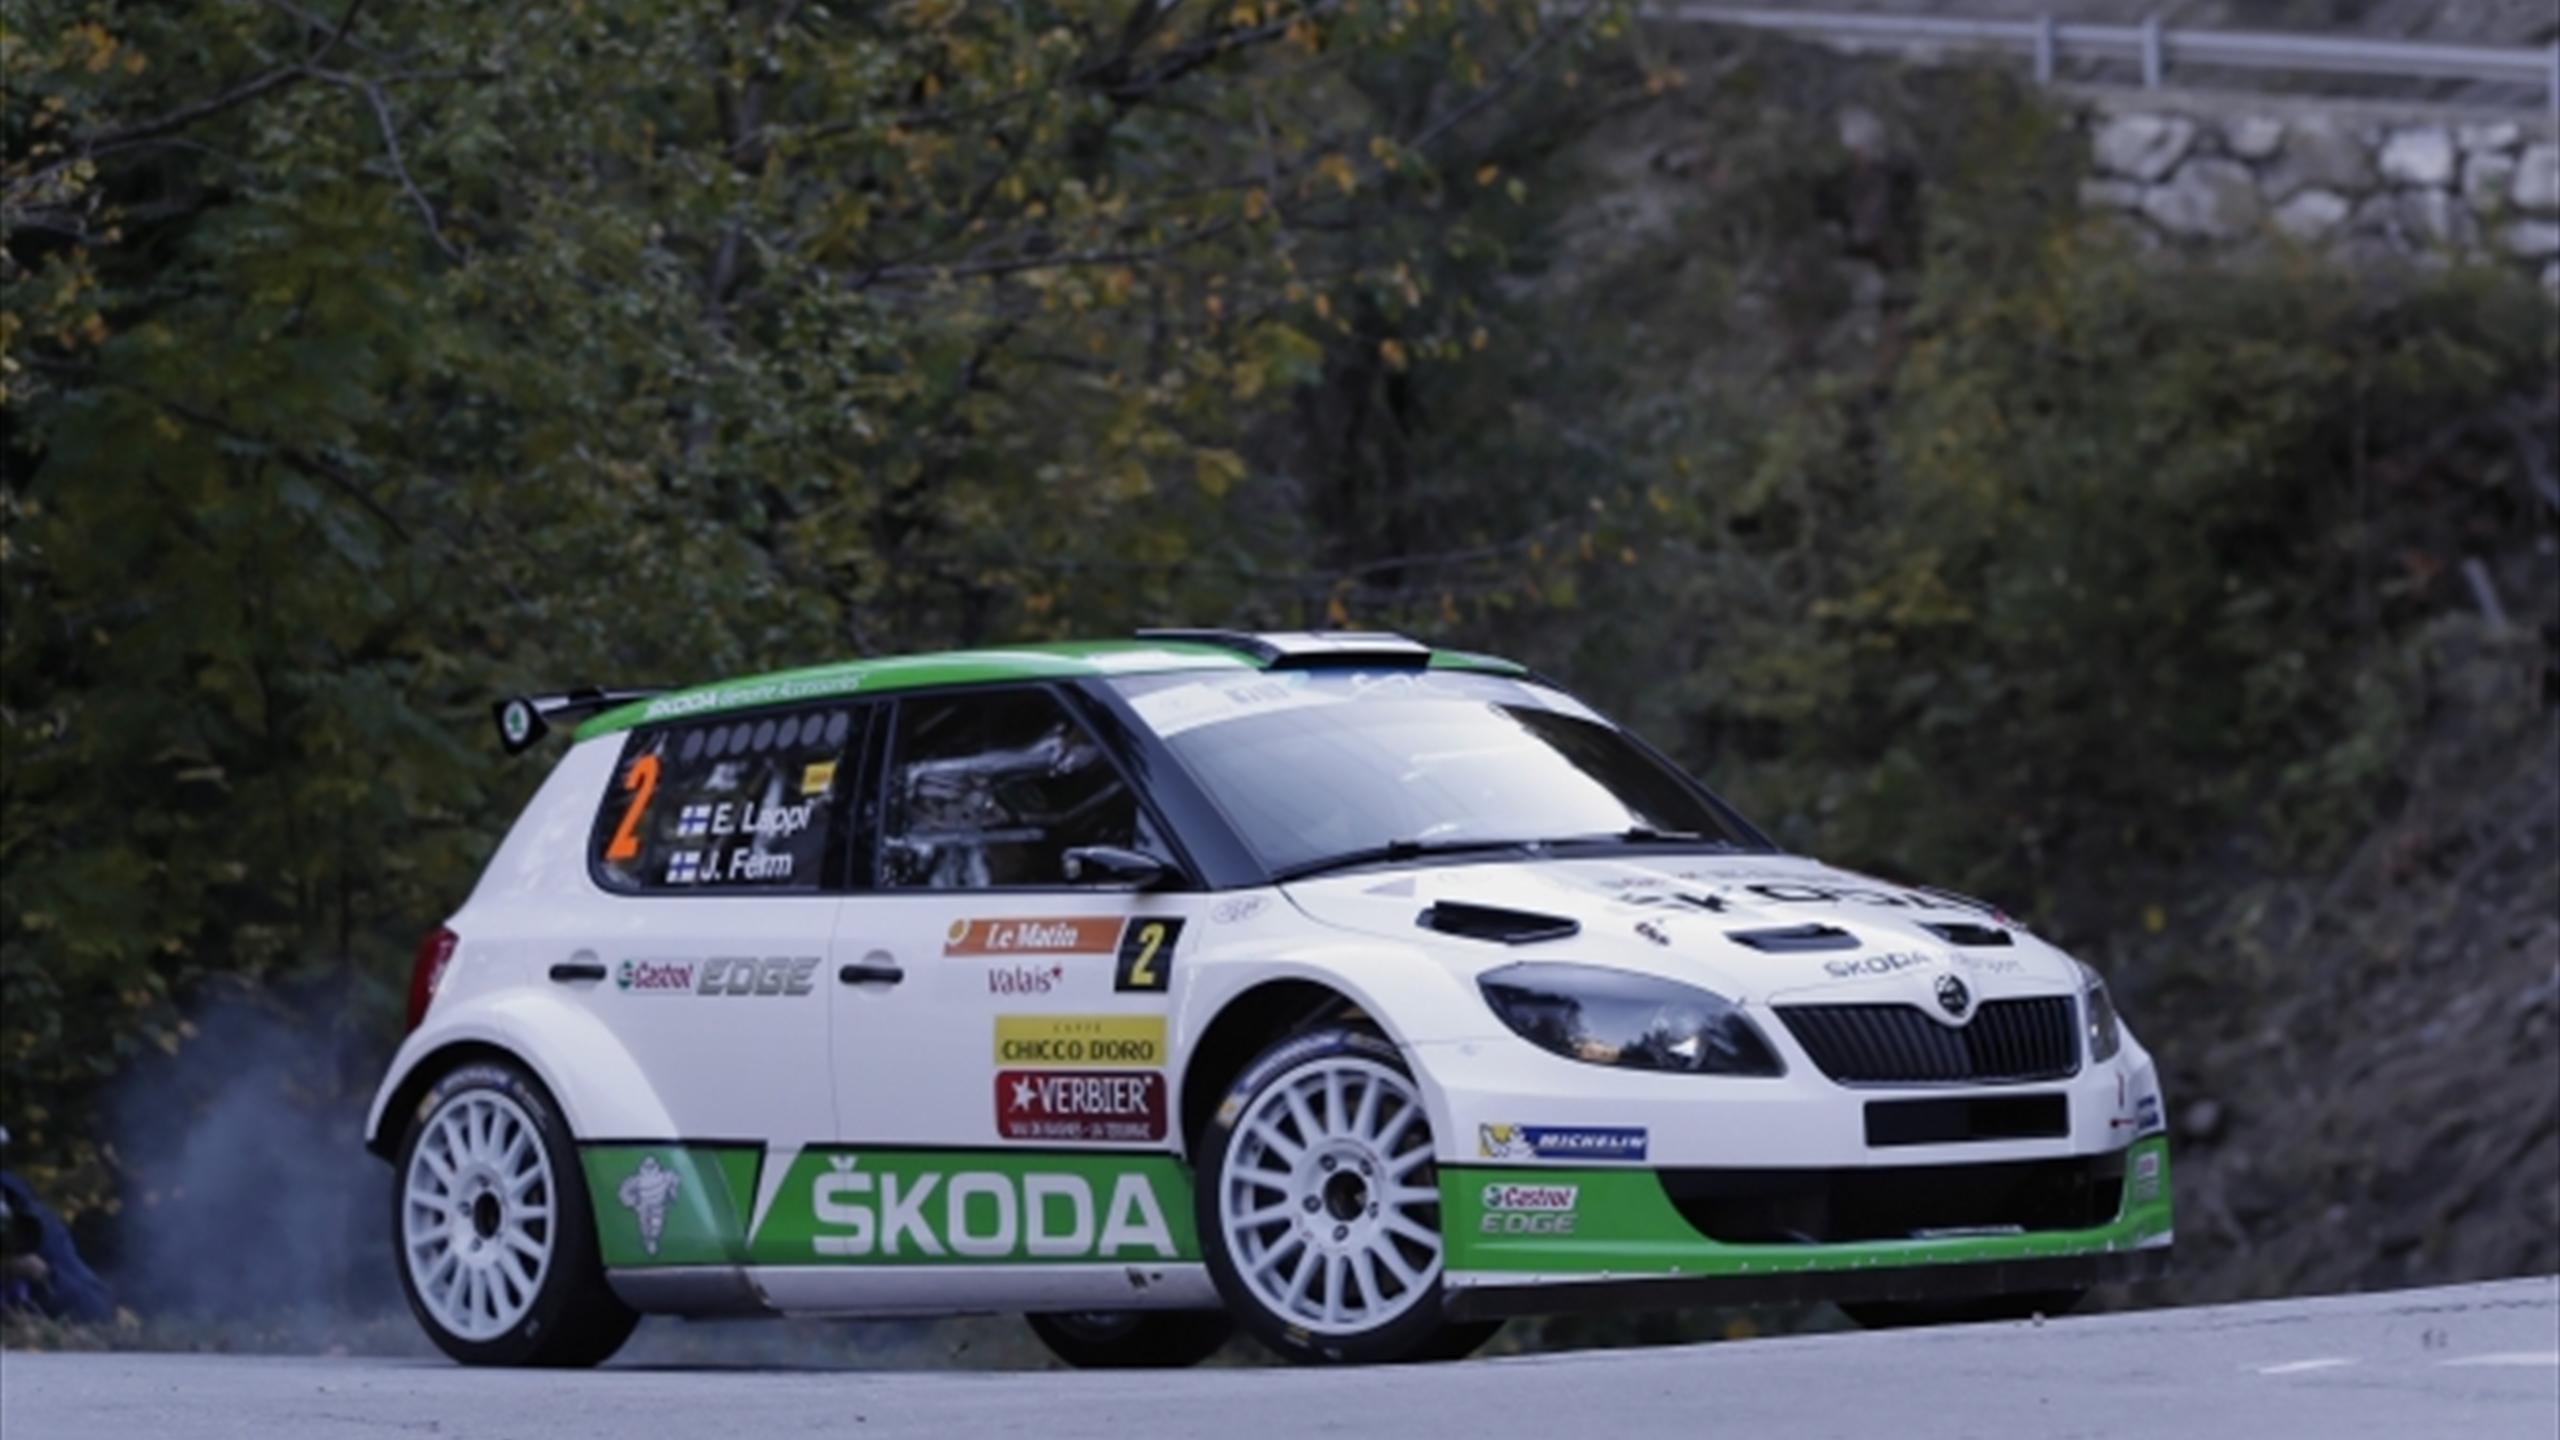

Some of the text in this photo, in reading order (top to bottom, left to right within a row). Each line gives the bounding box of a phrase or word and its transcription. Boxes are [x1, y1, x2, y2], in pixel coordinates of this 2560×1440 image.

[605, 753, 660, 861] 2
[711, 803, 811, 837] E. Lappi
[700, 852, 721, 881] J.
[986, 922, 1079, 948] Le Matin
[1129, 922, 1166, 986] 2
[635, 956, 822, 996] Castrol EDGE
[988, 966, 1052, 994] Valais
[1002, 1039, 1082, 1061] CHICCO
[1036, 1077, 1150, 1114] VERBIER
[1538, 1134, 1645, 1148] MICHELIN
[813, 1155, 1179, 1257] ŠKODA
[1504, 1187, 1571, 1207] Castrol
[1480, 1212, 1577, 1234] EDGE
